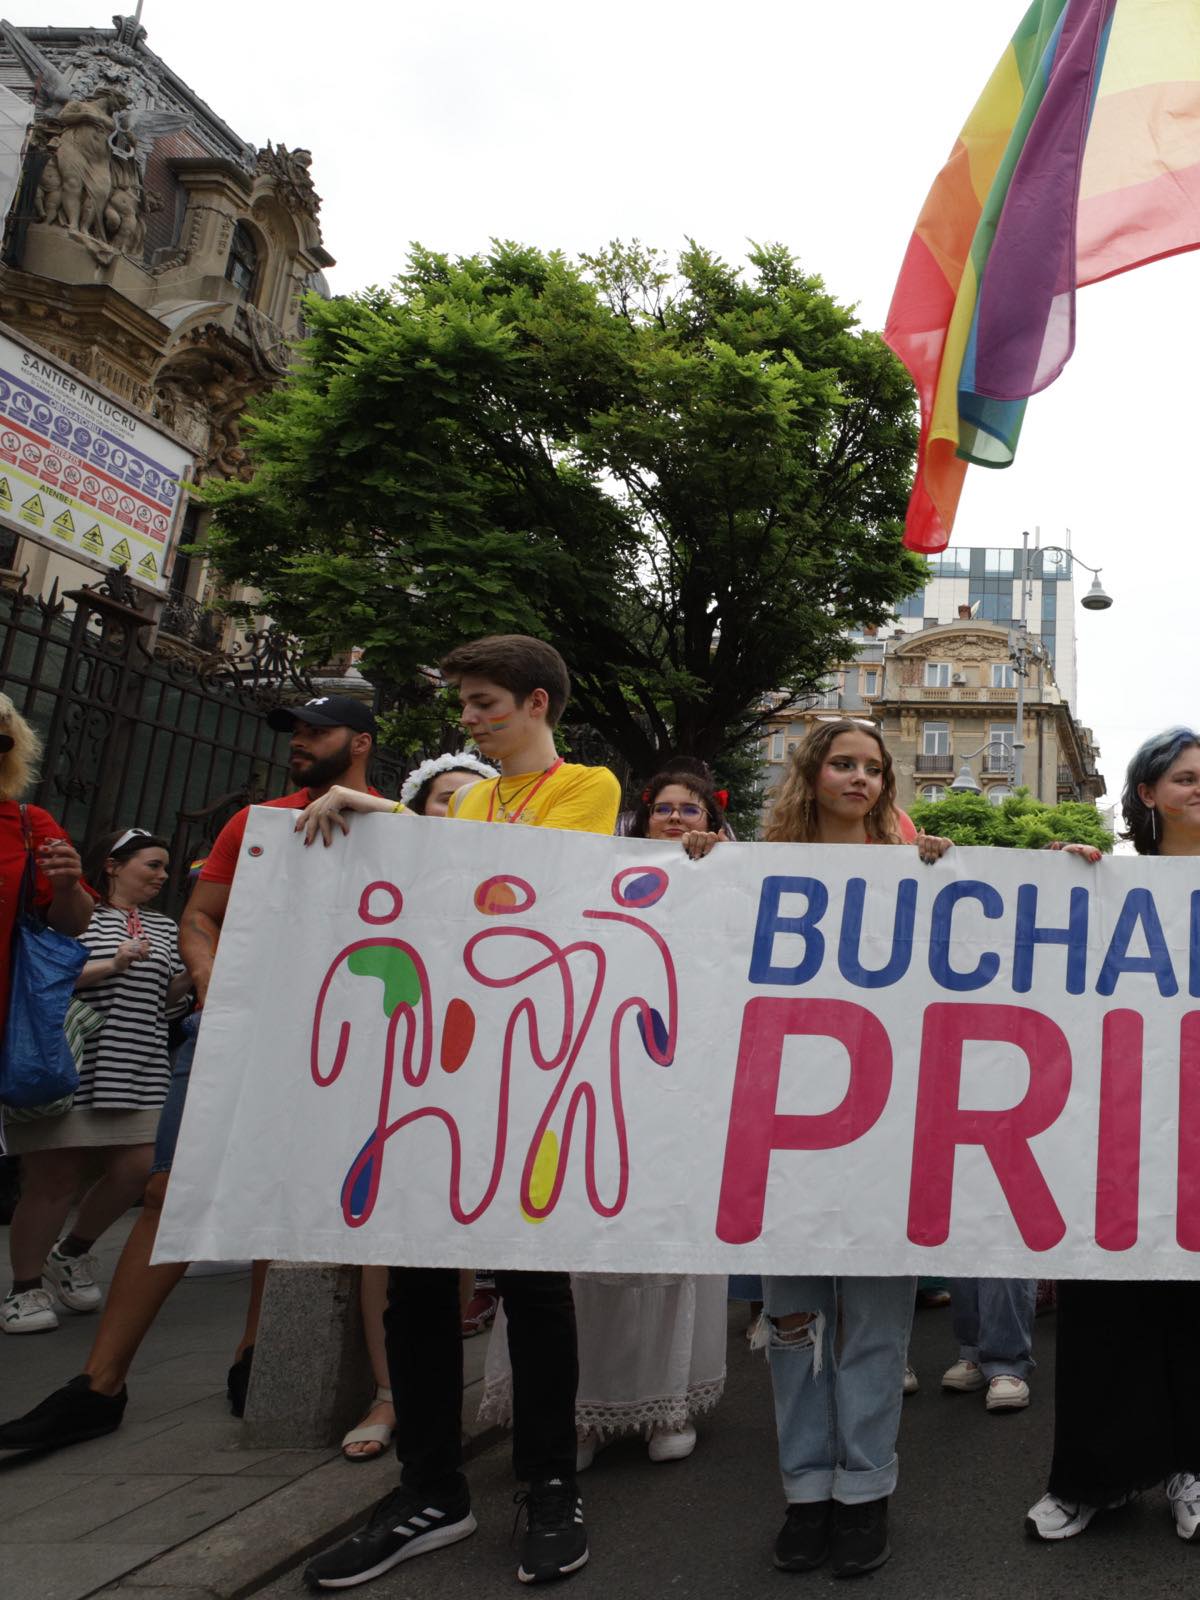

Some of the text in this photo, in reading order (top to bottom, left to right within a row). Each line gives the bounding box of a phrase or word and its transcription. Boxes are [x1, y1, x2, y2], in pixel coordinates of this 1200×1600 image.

[22, 353, 137, 432] SANTIER IN LUCRU
